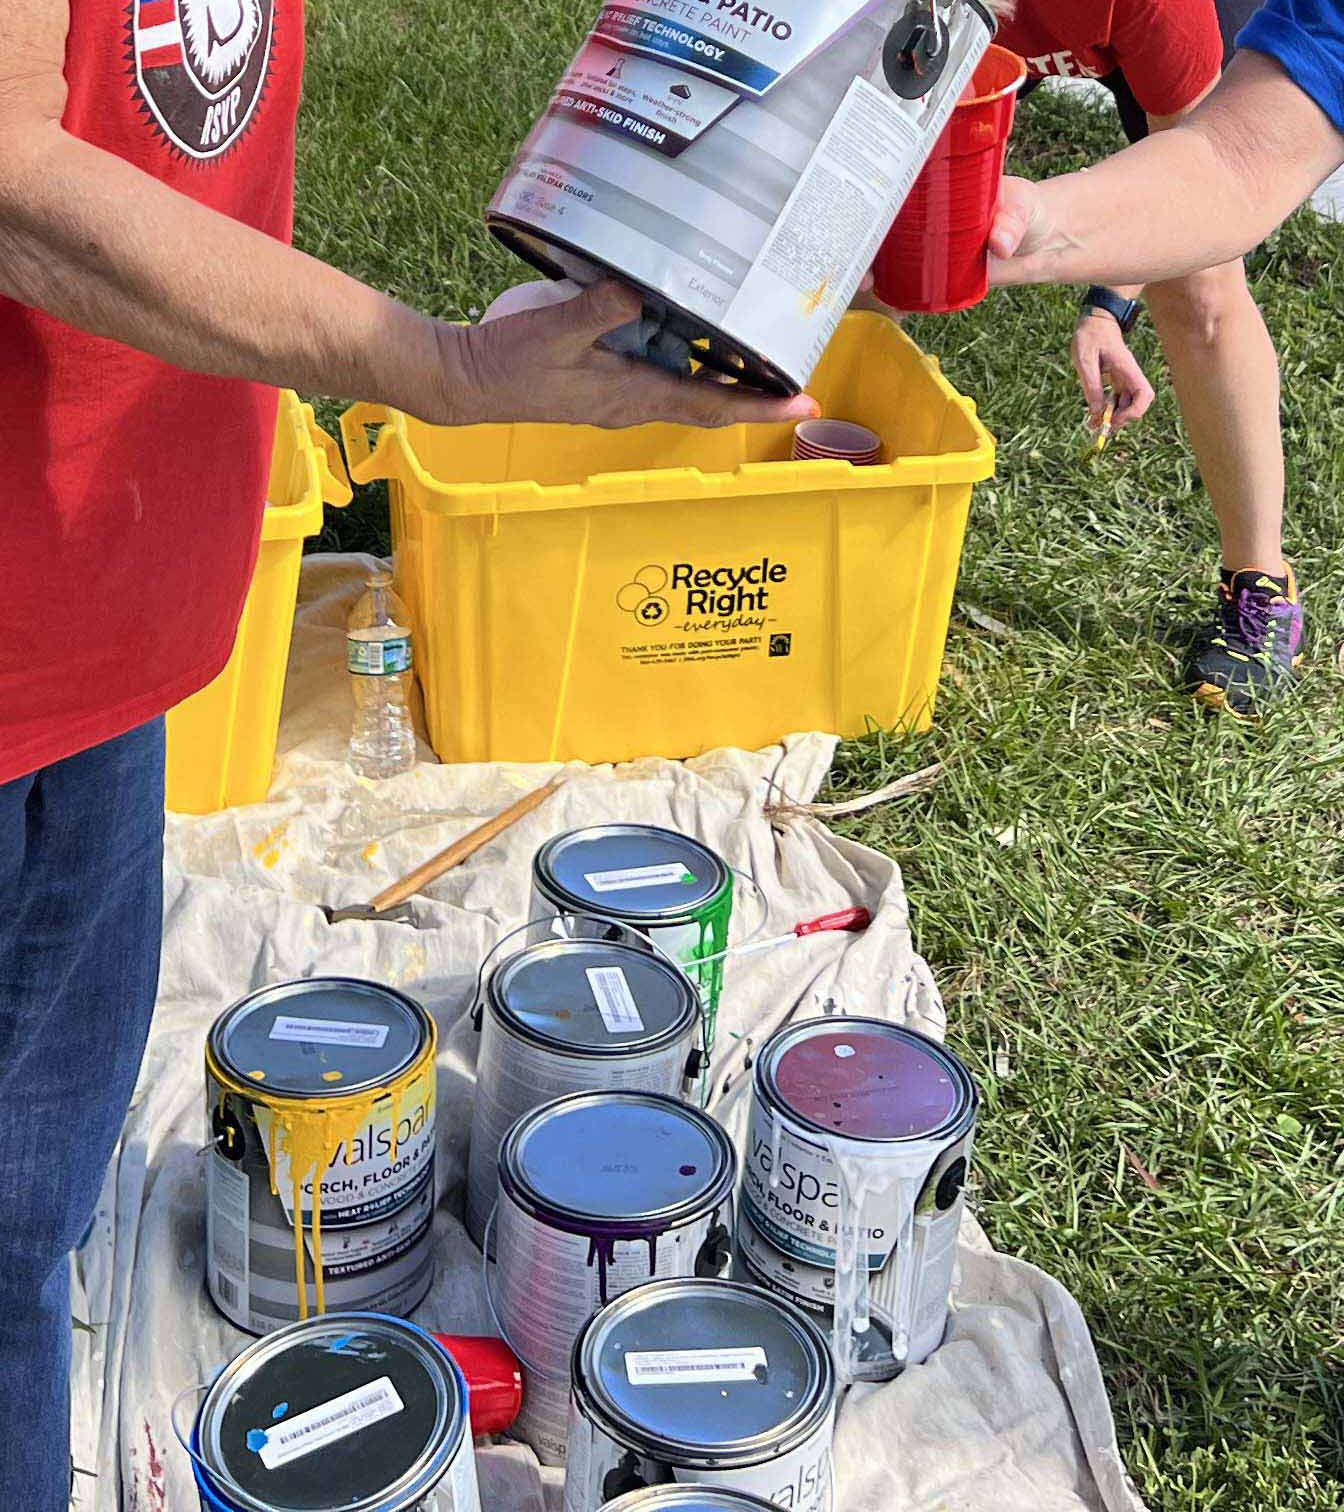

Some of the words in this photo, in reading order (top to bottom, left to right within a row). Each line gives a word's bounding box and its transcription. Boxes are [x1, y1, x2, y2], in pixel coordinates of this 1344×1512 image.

[642, 17, 726, 62] TECHNOLOGY
[700, 12, 752, 43] PAINT
[200, 85, 241, 145] RSVP
[574, 98, 623, 126] ANTI-SKID
[622, 117, 667, 145] FINISH
[563, 183, 594, 202] COLORS
[672, 558, 787, 590] Recycle
[686, 586, 769, 617] Right
[621, 646, 648, 654] THANK
[670, 642, 685, 650] FOR
[688, 640, 713, 649] DOING
[715, 638, 737, 647] YOUR
[300, 1178, 358, 1195] ORCH,
[363, 1157, 411, 1187] FLOOR
[338, 1207, 362, 1219] HEAT
[767, 1190, 815, 1227] FLOOR
[819, 1220, 830, 1233] &
[327, 1259, 375, 1276] TEXTURED
